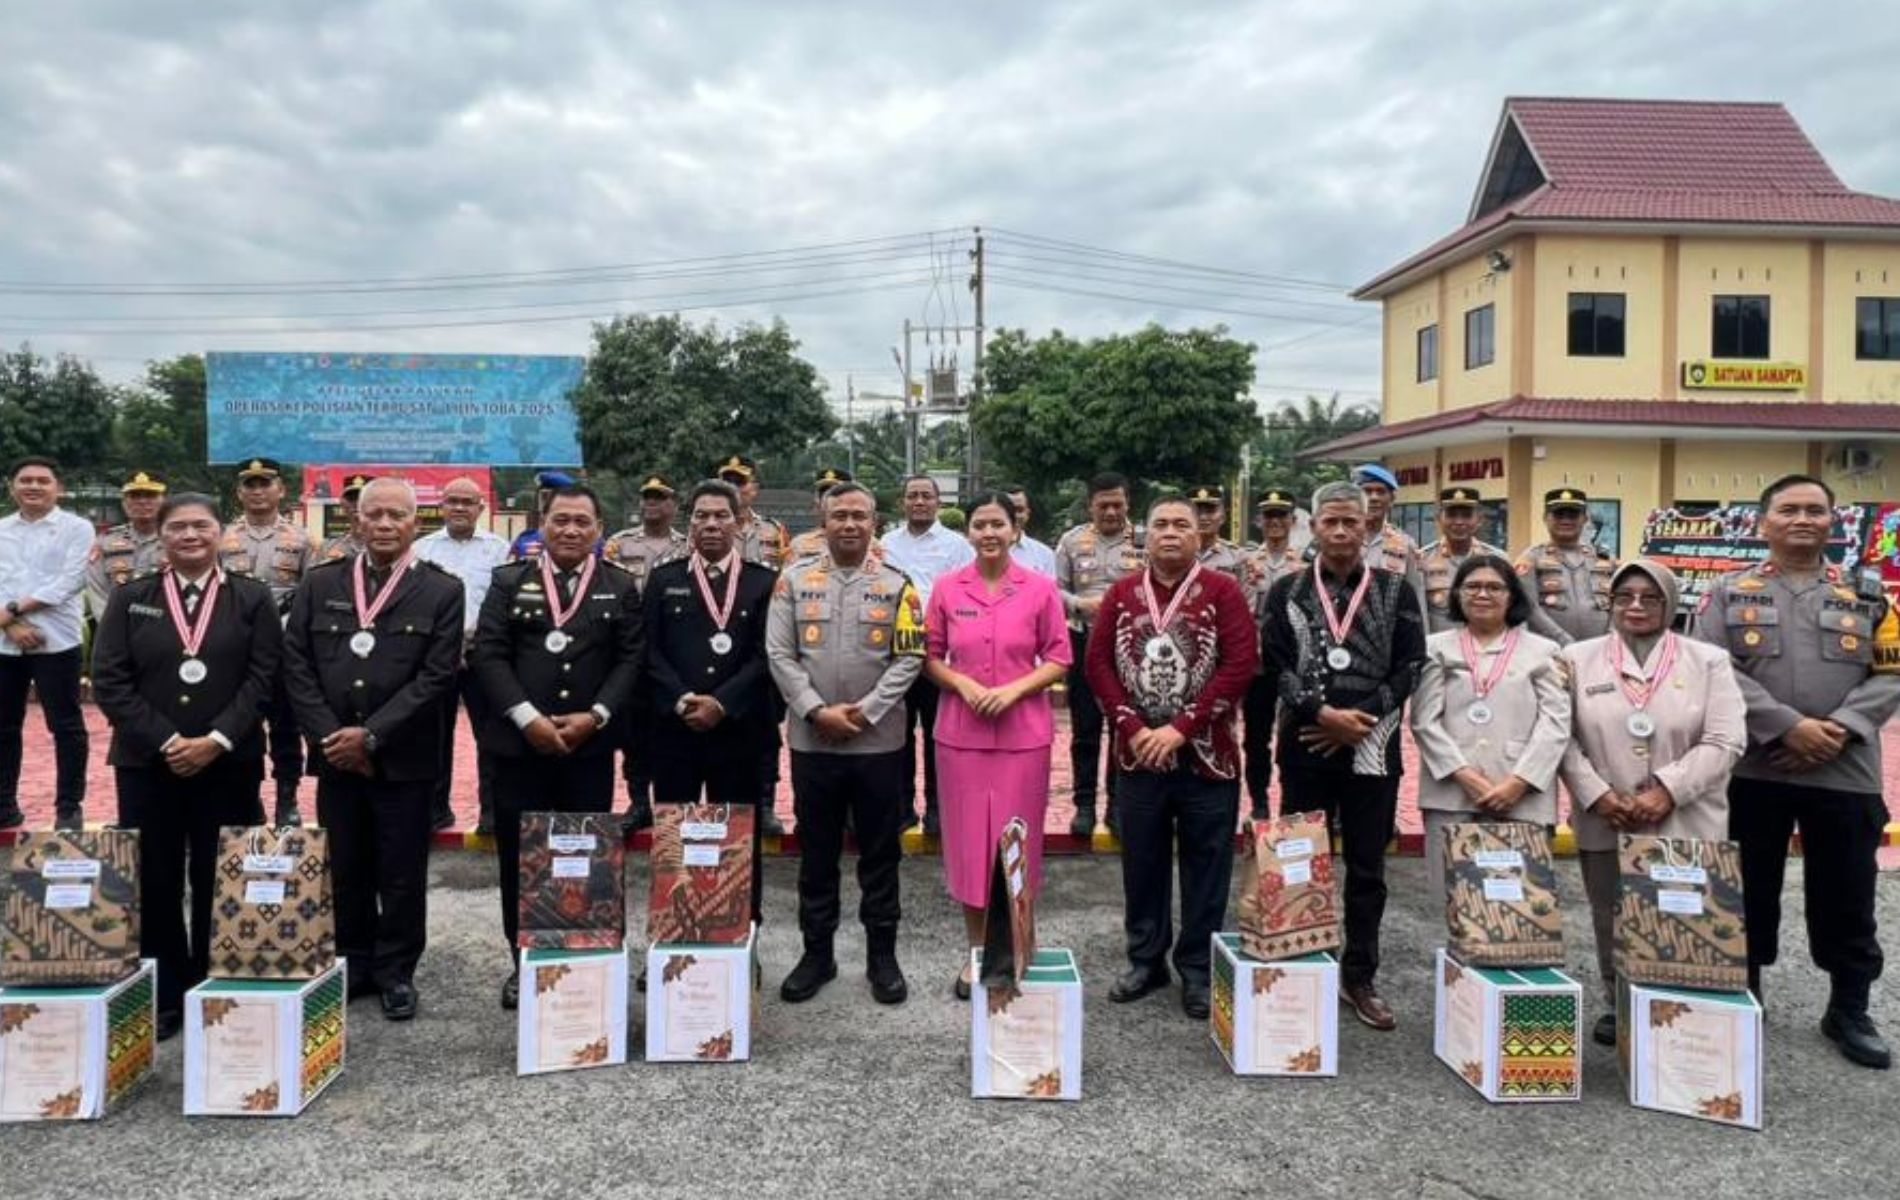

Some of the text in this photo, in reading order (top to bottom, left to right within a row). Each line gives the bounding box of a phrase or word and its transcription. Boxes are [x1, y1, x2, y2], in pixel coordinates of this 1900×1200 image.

[1714, 366, 1803, 383] SATUAN SAMAPTA
[520, 403, 556, 416] 2025
[1449, 457, 1505, 481] SAMAPTA
